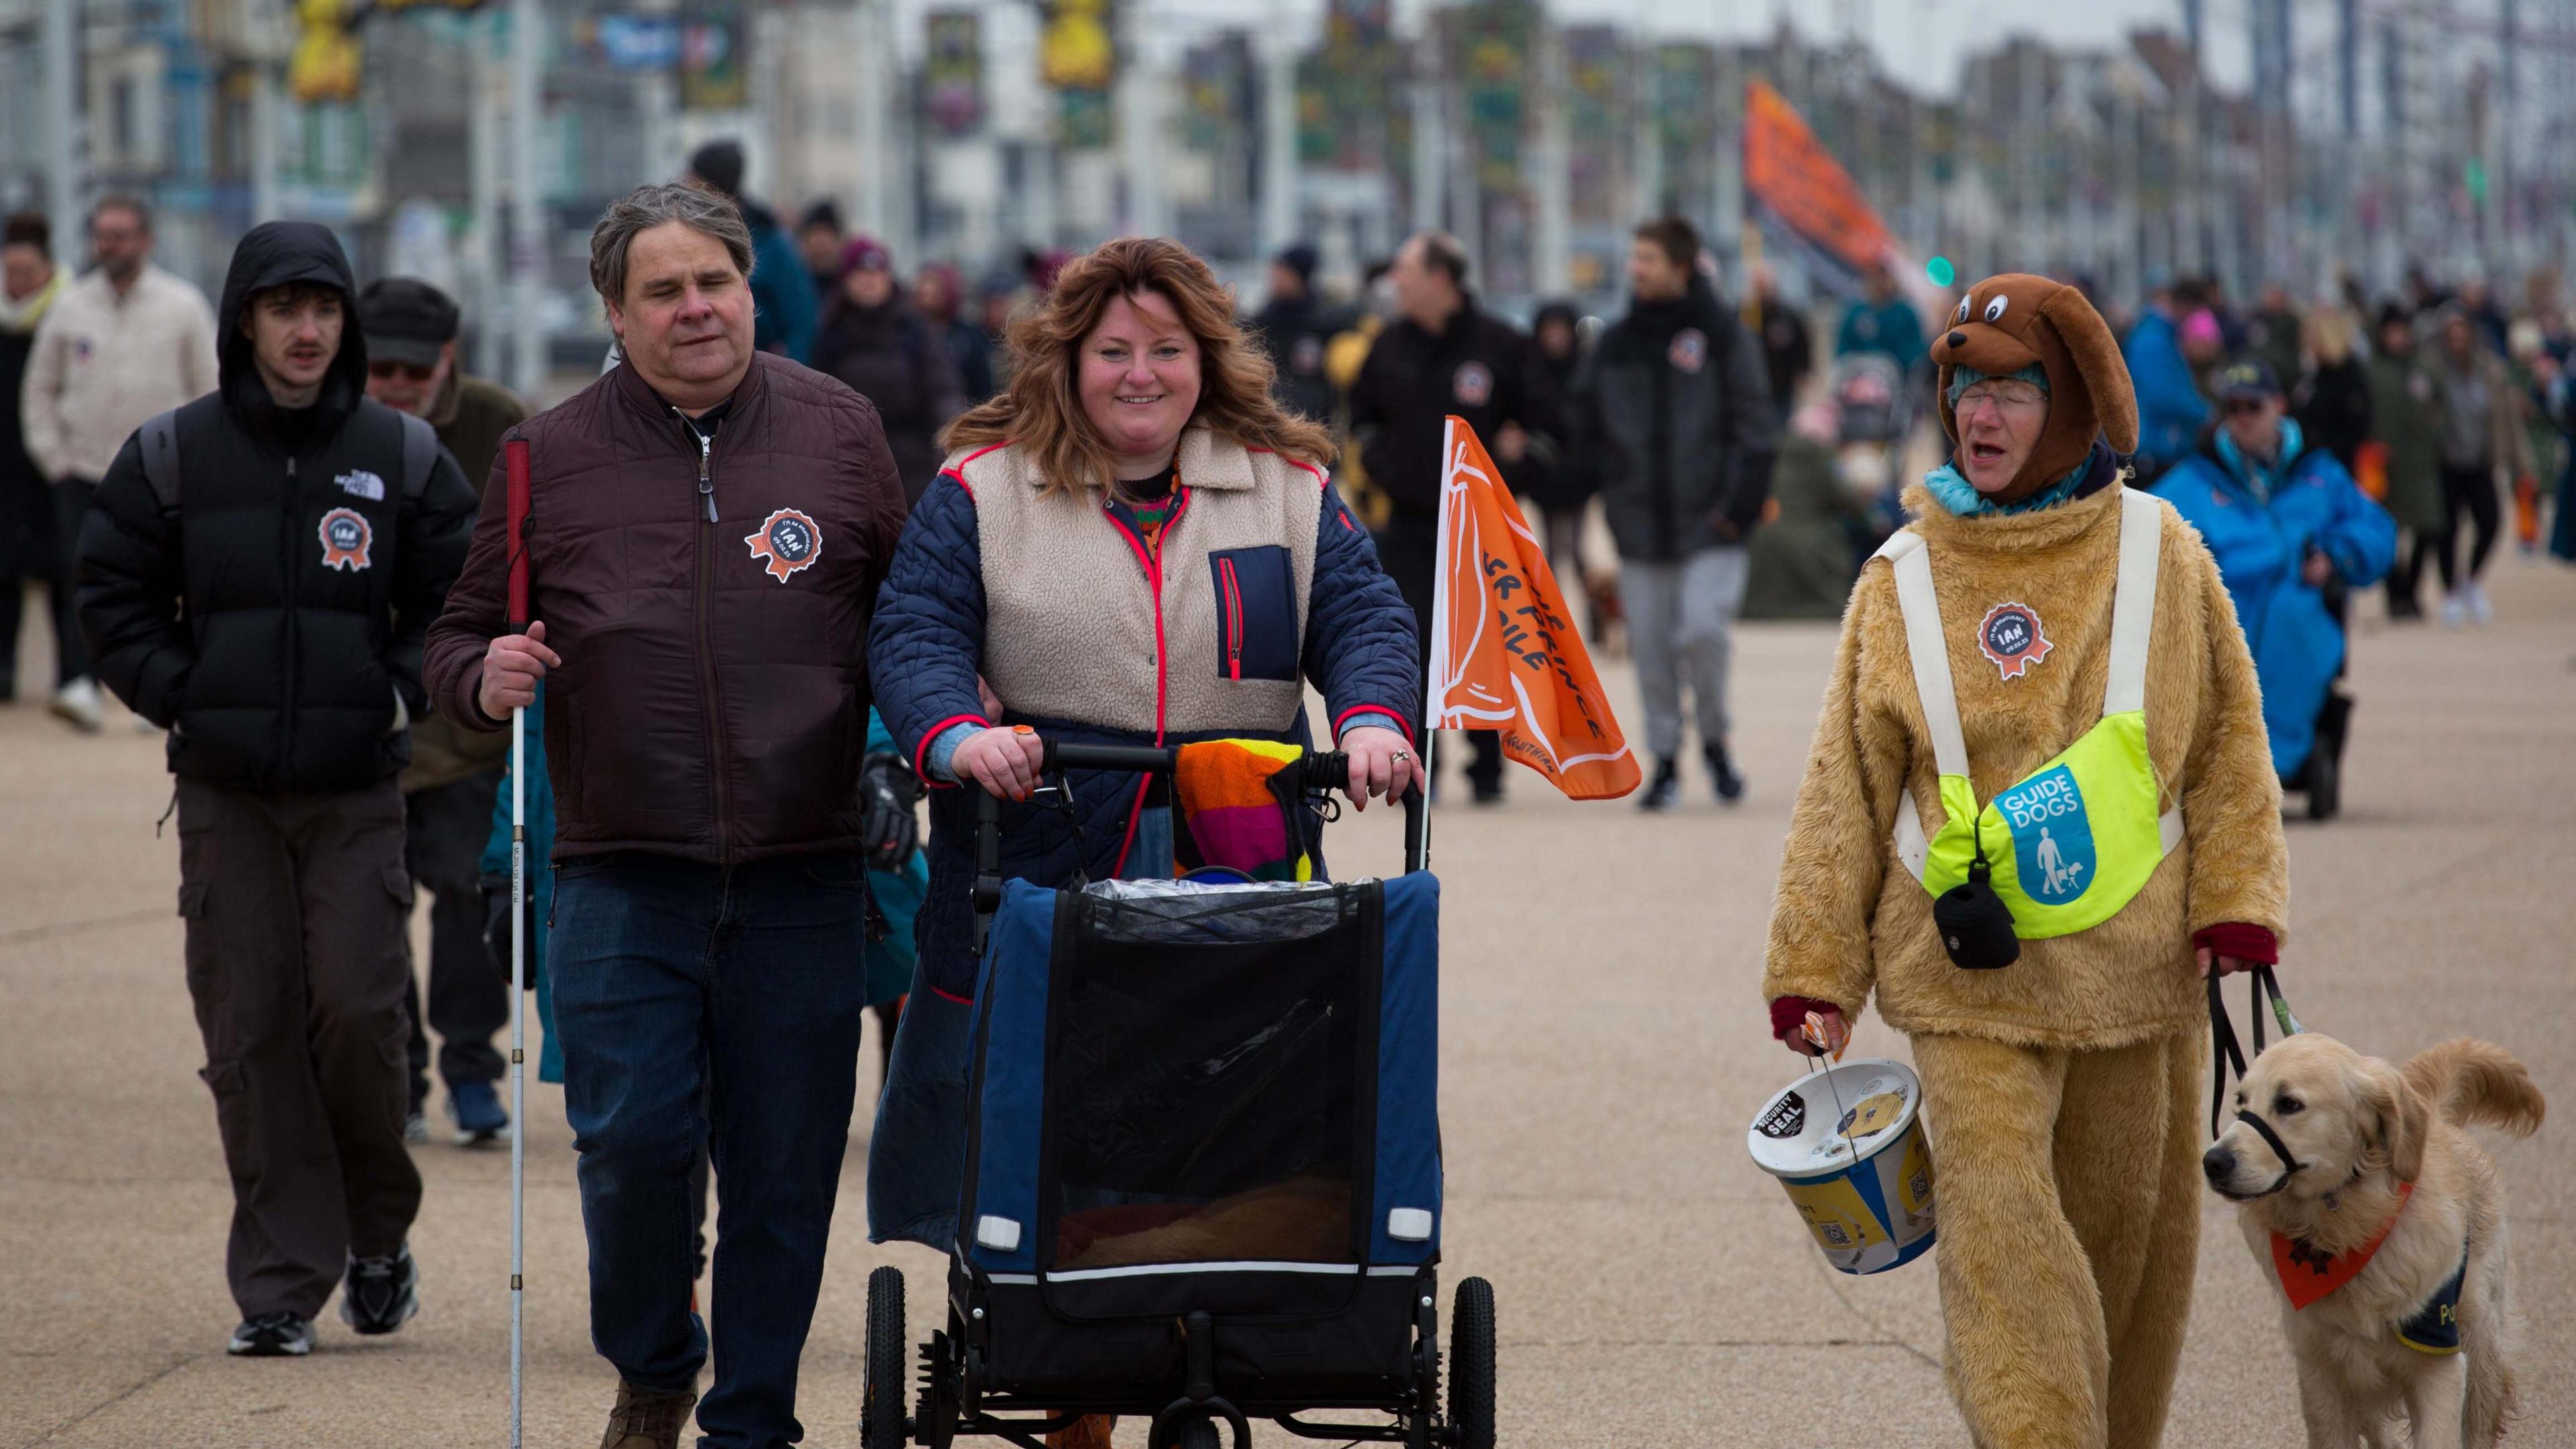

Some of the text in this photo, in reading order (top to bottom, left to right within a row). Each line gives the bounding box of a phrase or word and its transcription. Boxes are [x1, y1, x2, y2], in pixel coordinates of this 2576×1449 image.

[773, 536, 792, 558] 09.02.25
[780, 527, 803, 551] IAN
[1998, 624, 2023, 645] IAN
[1517, 606, 1607, 740] PRINCE
[2004, 774, 2072, 810] GUIDE
[2012, 793, 2078, 828] DOGS
[1758, 1095, 1792, 1127] SECURITY
[1768, 1106, 1802, 1135] SEAL
[2440, 1303, 2459, 1326] PU
